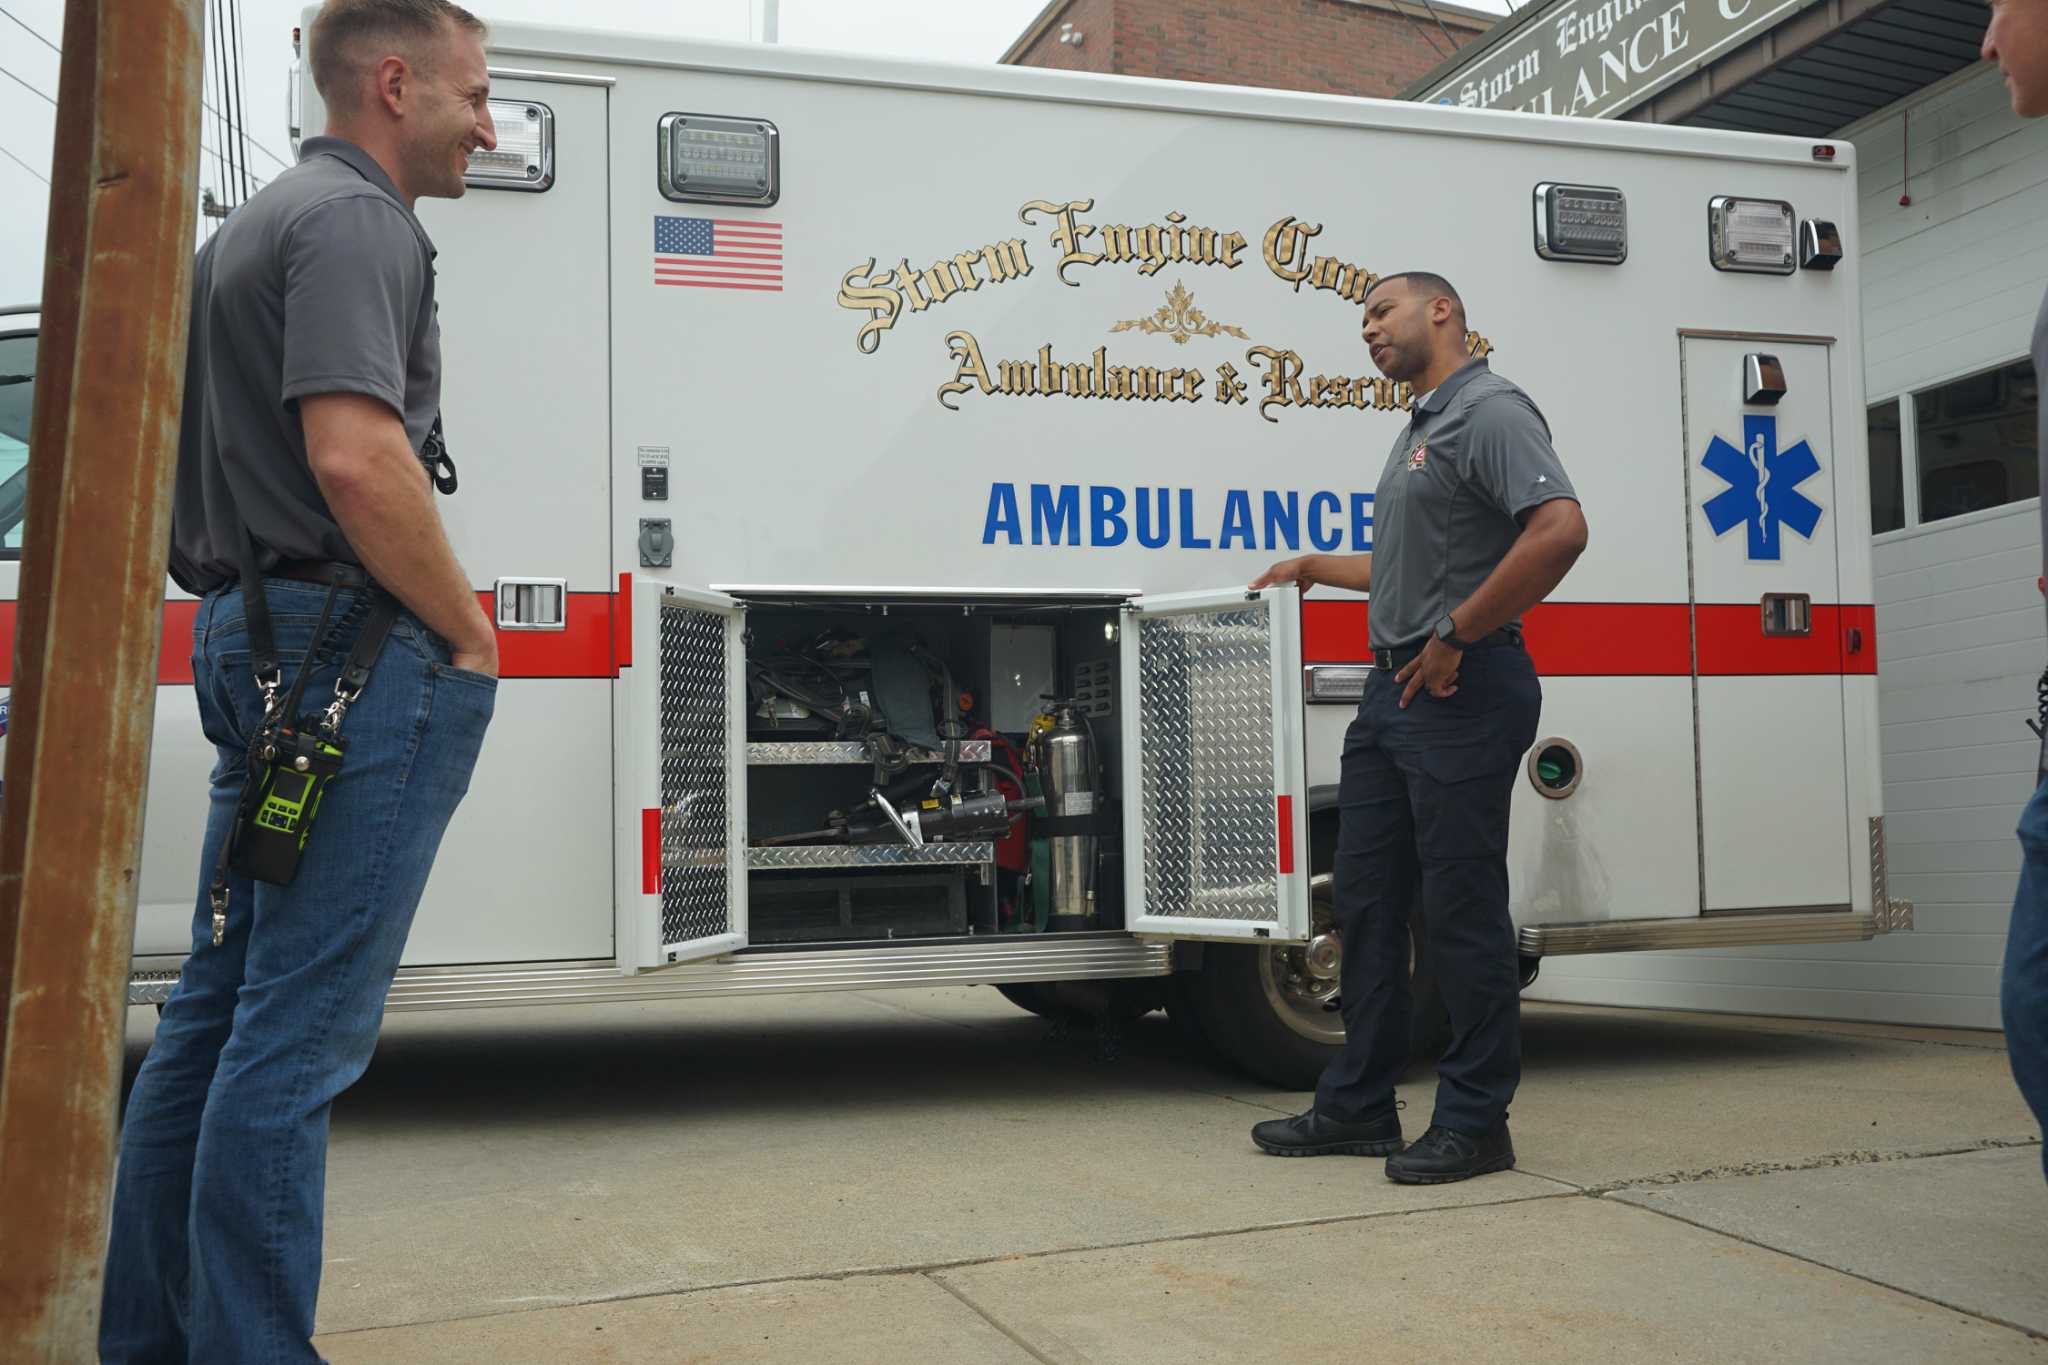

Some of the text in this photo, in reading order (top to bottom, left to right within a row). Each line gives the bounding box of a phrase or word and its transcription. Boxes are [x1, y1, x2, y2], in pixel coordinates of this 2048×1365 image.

[1458, 48, 1540, 108] Storm
[837, 237, 1034, 354] Storm
[1018, 198, 1248, 287] Engine
[937, 330, 1416, 423] Ambulance & Rescue
[982, 482, 1376, 552] AMBULANCE
